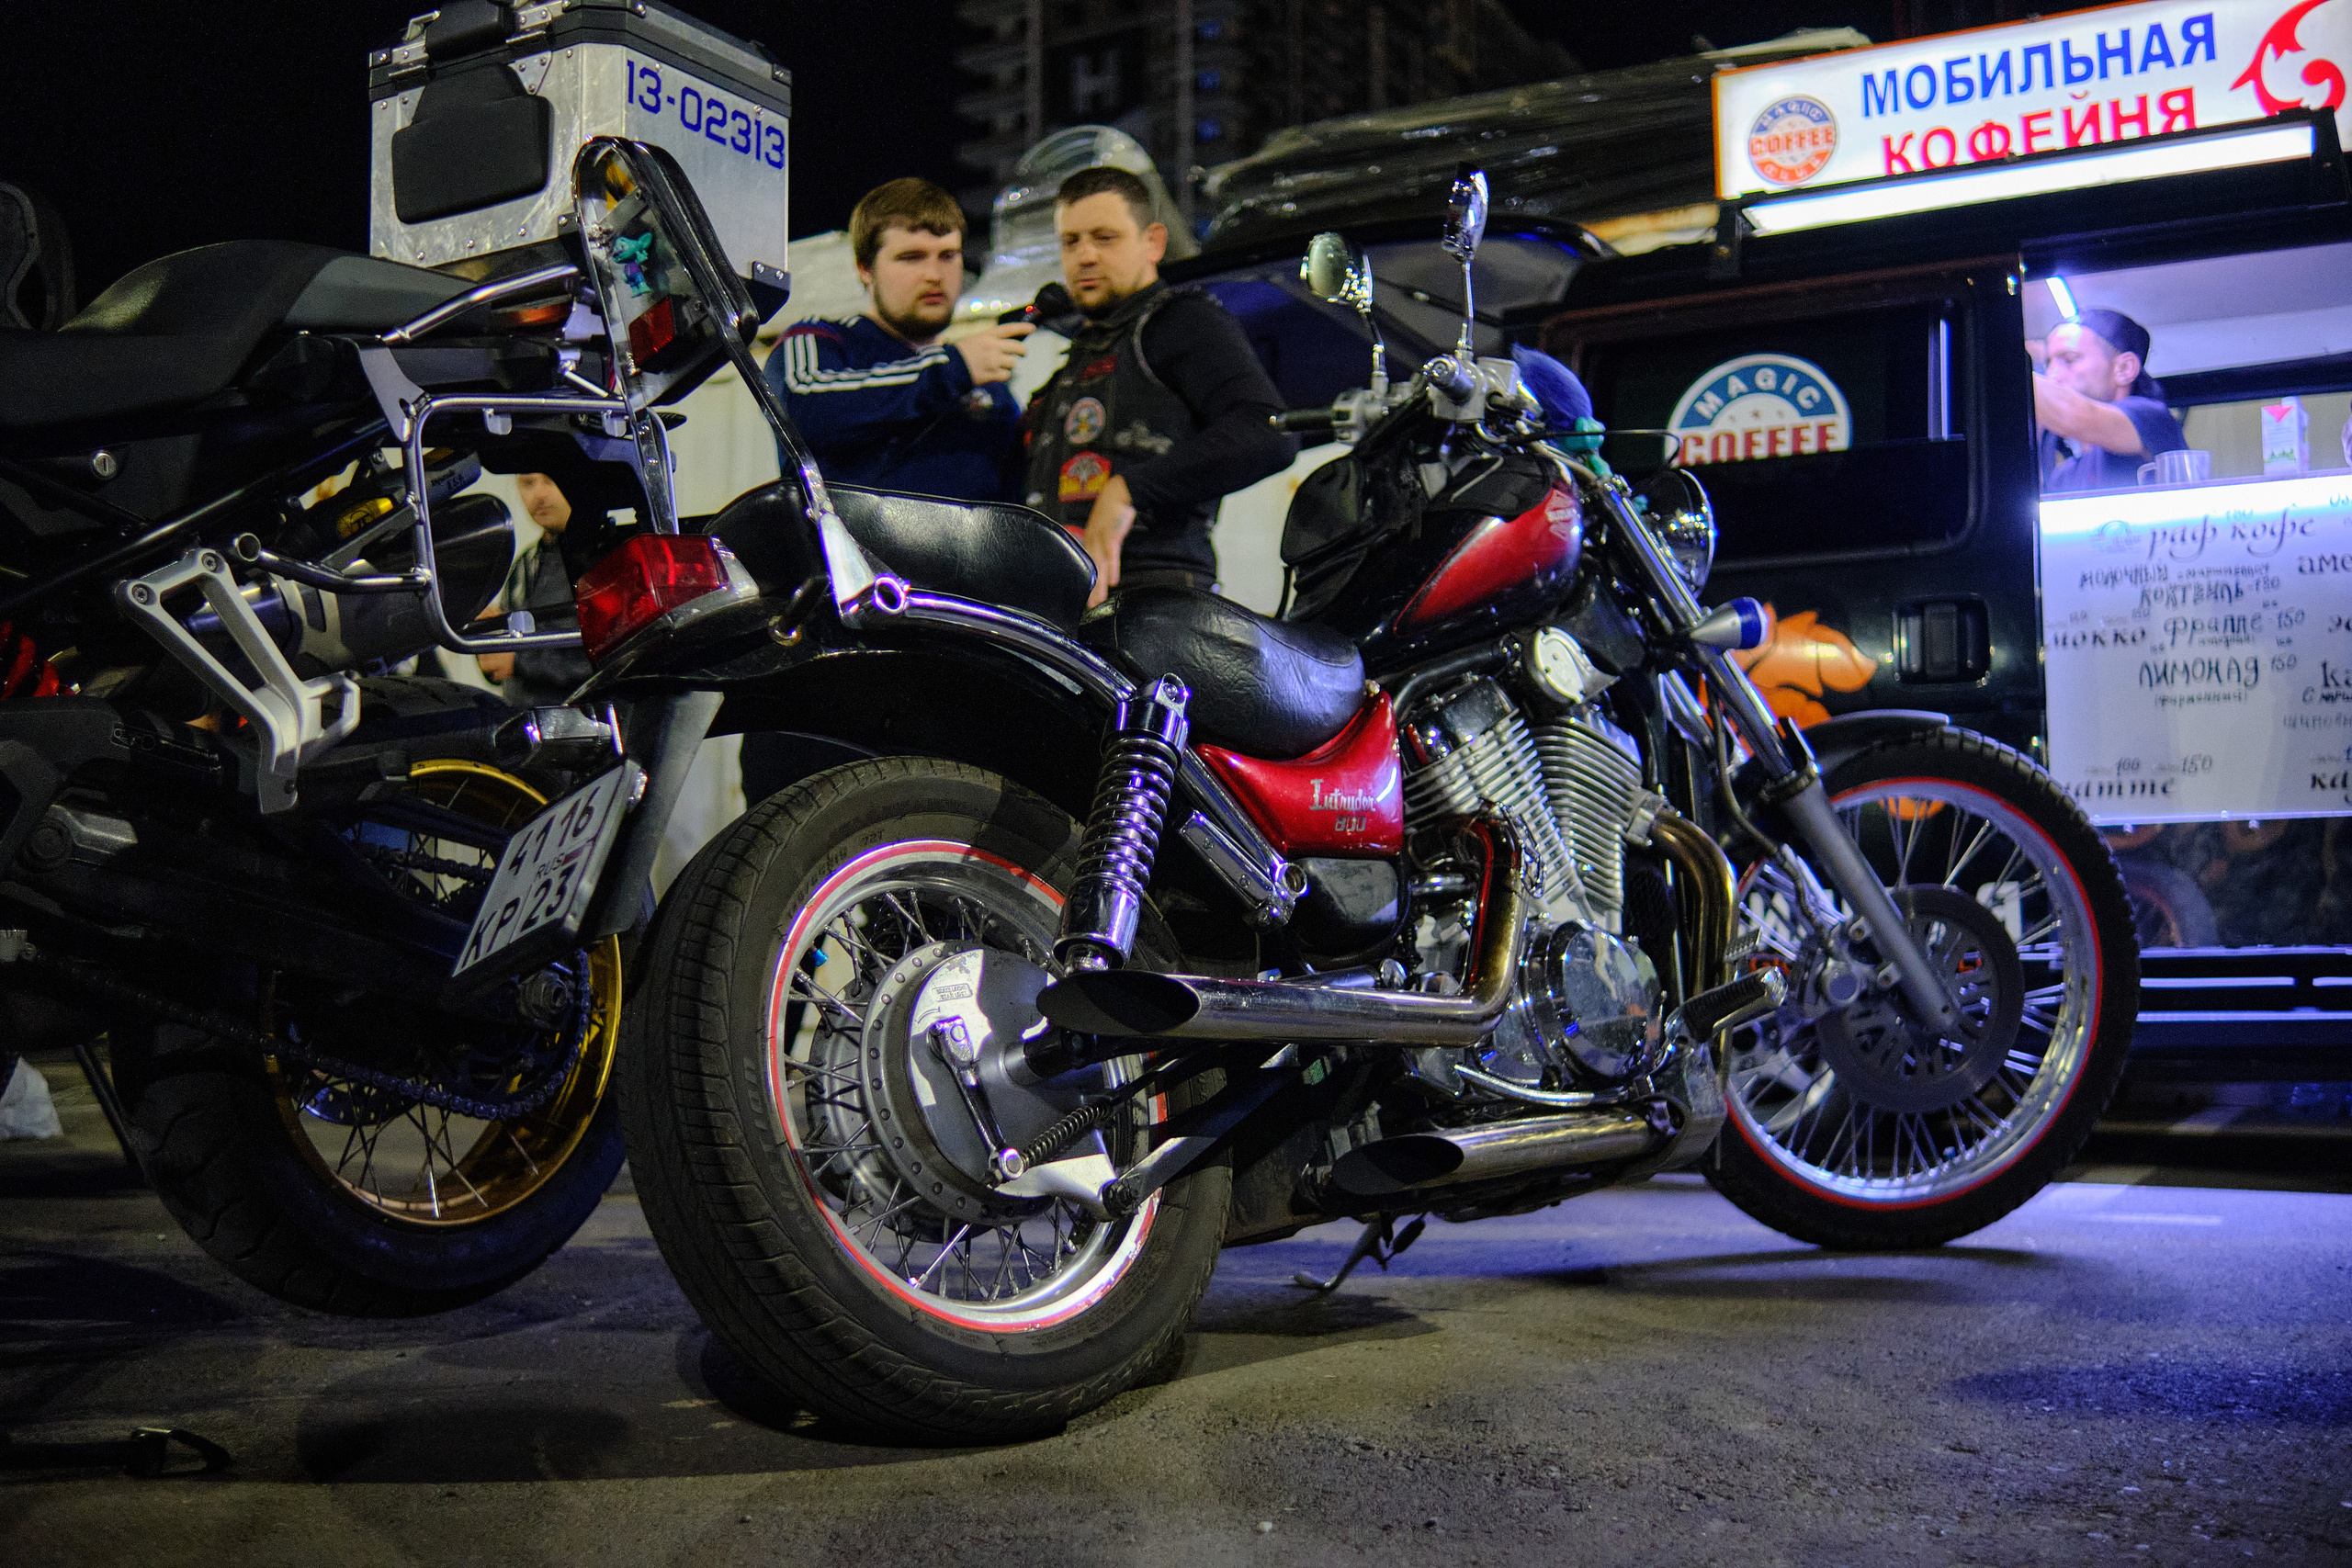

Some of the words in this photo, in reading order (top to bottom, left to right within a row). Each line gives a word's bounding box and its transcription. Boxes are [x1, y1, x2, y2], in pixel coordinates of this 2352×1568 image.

[1860, 12, 2218, 118] МОБИЛЬНАЯ
[627, 60, 786, 170] 13-02313
[1749, 125, 1834, 156] COFFEE
[1882, 86, 2197, 175] КОФЕЙНЯ
[1694, 367, 1821, 420] MAGIC
[2149, 515, 2218, 560] раф
[2231, 510, 2316, 558] кофе
[1309, 778, 1376, 812] Intruder
[509, 786, 601, 876] 4116
[1334, 816, 1367, 832] 800
[536, 852, 566, 882] RUS
[520, 862, 579, 932] 23
